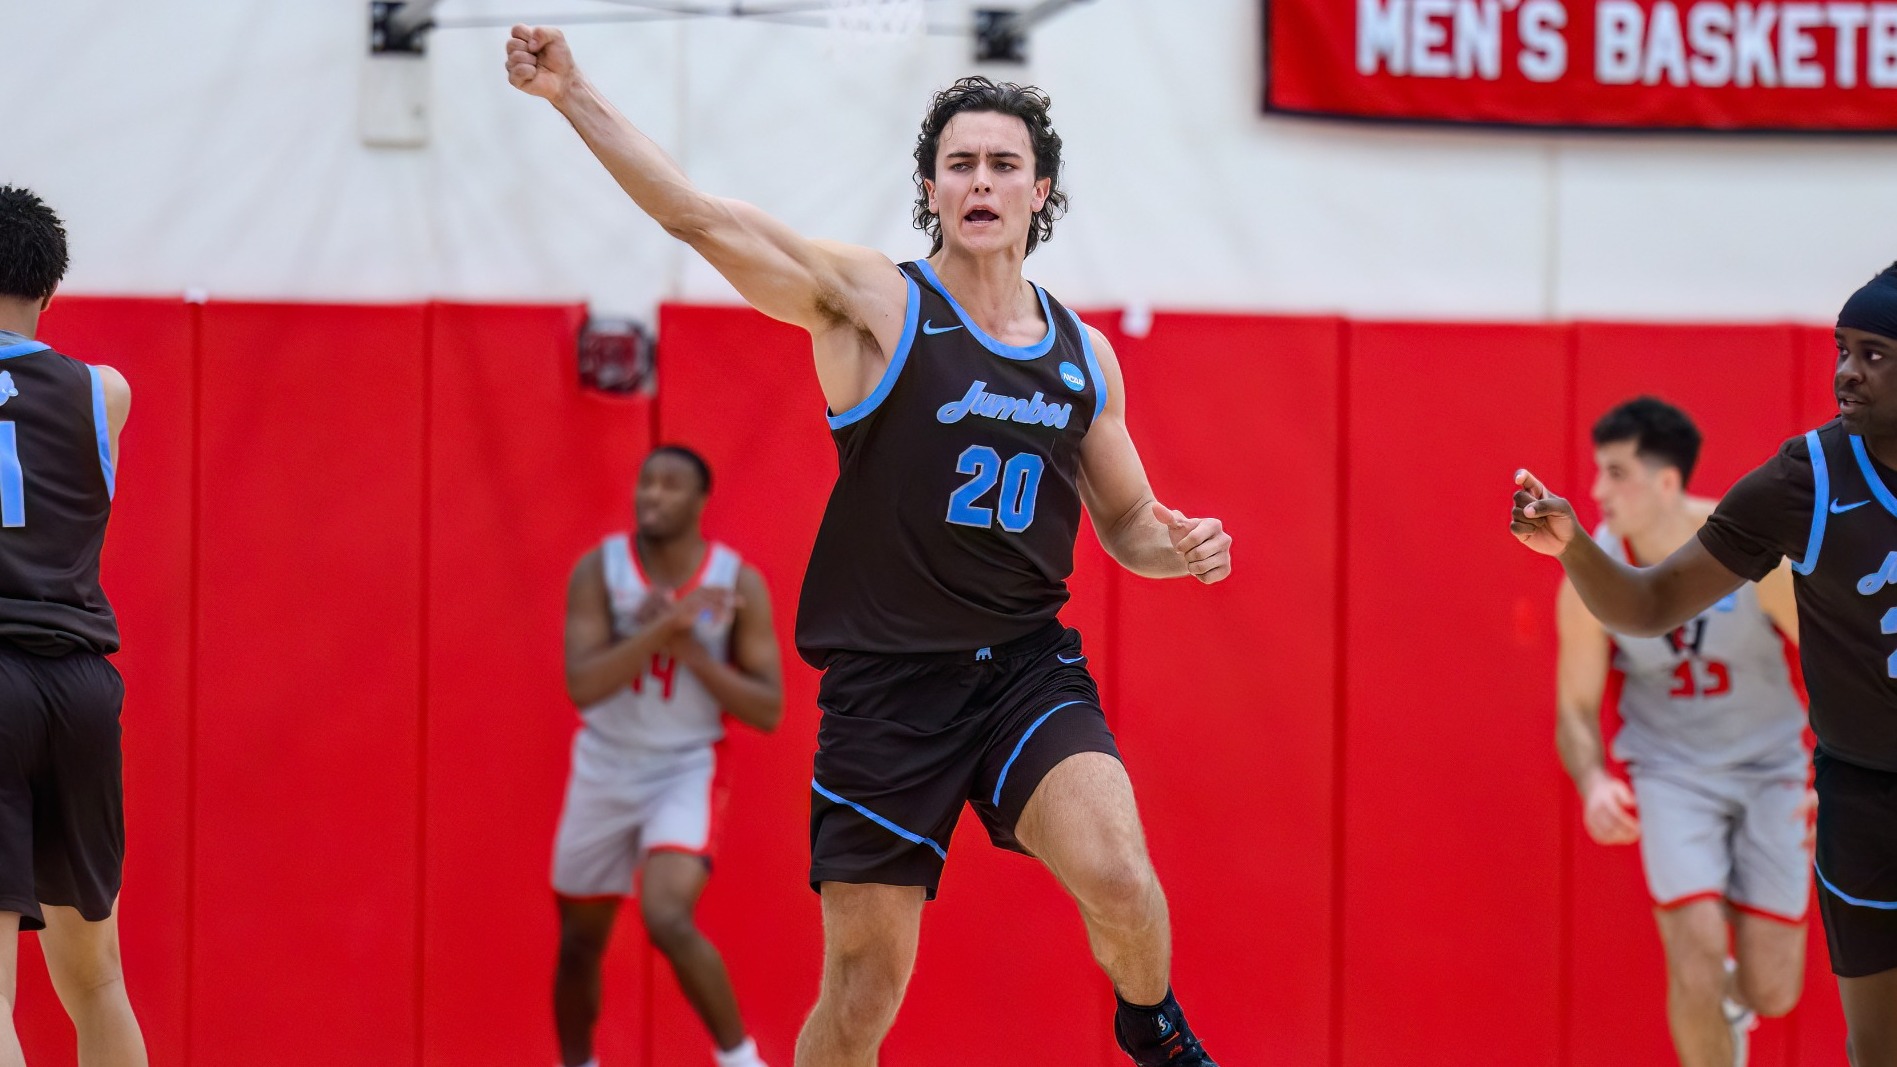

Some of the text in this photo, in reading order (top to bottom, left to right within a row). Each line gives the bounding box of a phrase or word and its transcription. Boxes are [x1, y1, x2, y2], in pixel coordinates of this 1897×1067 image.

[1355, 0, 1568, 82] MEN'S
[936, 380, 1073, 430] Jumbos
[1062, 372, 1085, 387] NCAA
[945, 444, 1045, 533] 20
